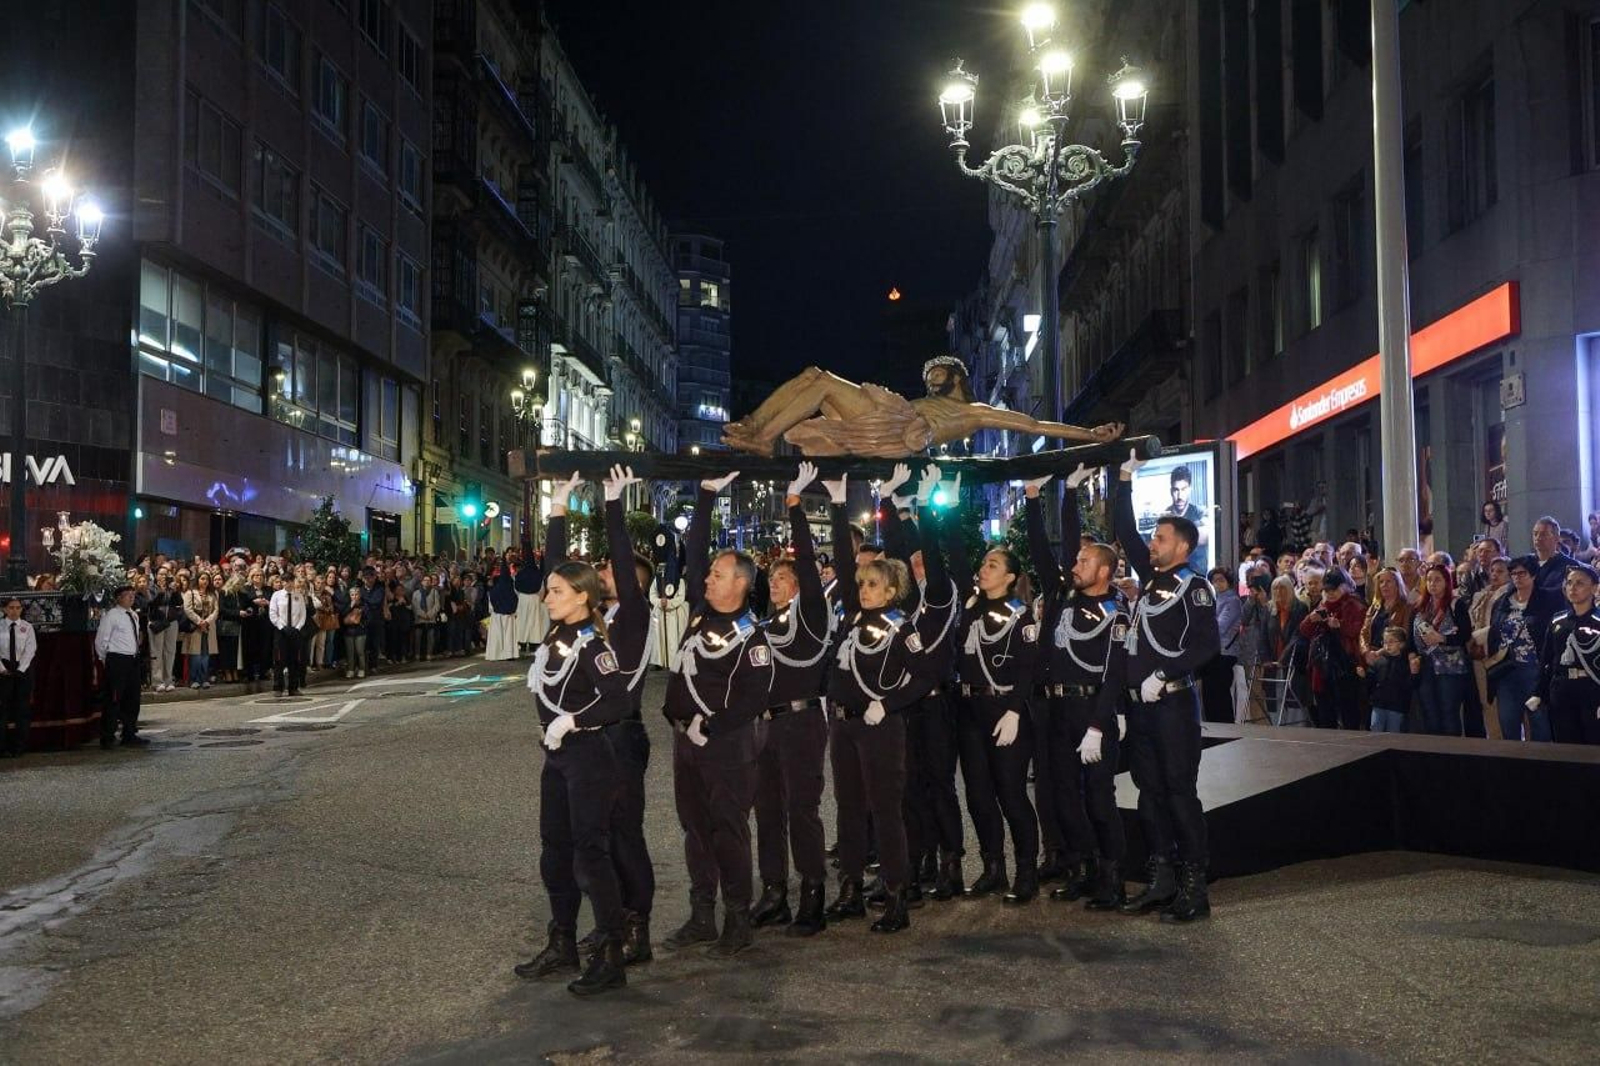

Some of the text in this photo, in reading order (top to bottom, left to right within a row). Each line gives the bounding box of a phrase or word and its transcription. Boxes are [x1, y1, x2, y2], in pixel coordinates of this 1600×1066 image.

[1299, 378, 1367, 426] Santander Empresas
[0, 452, 76, 485] VA
